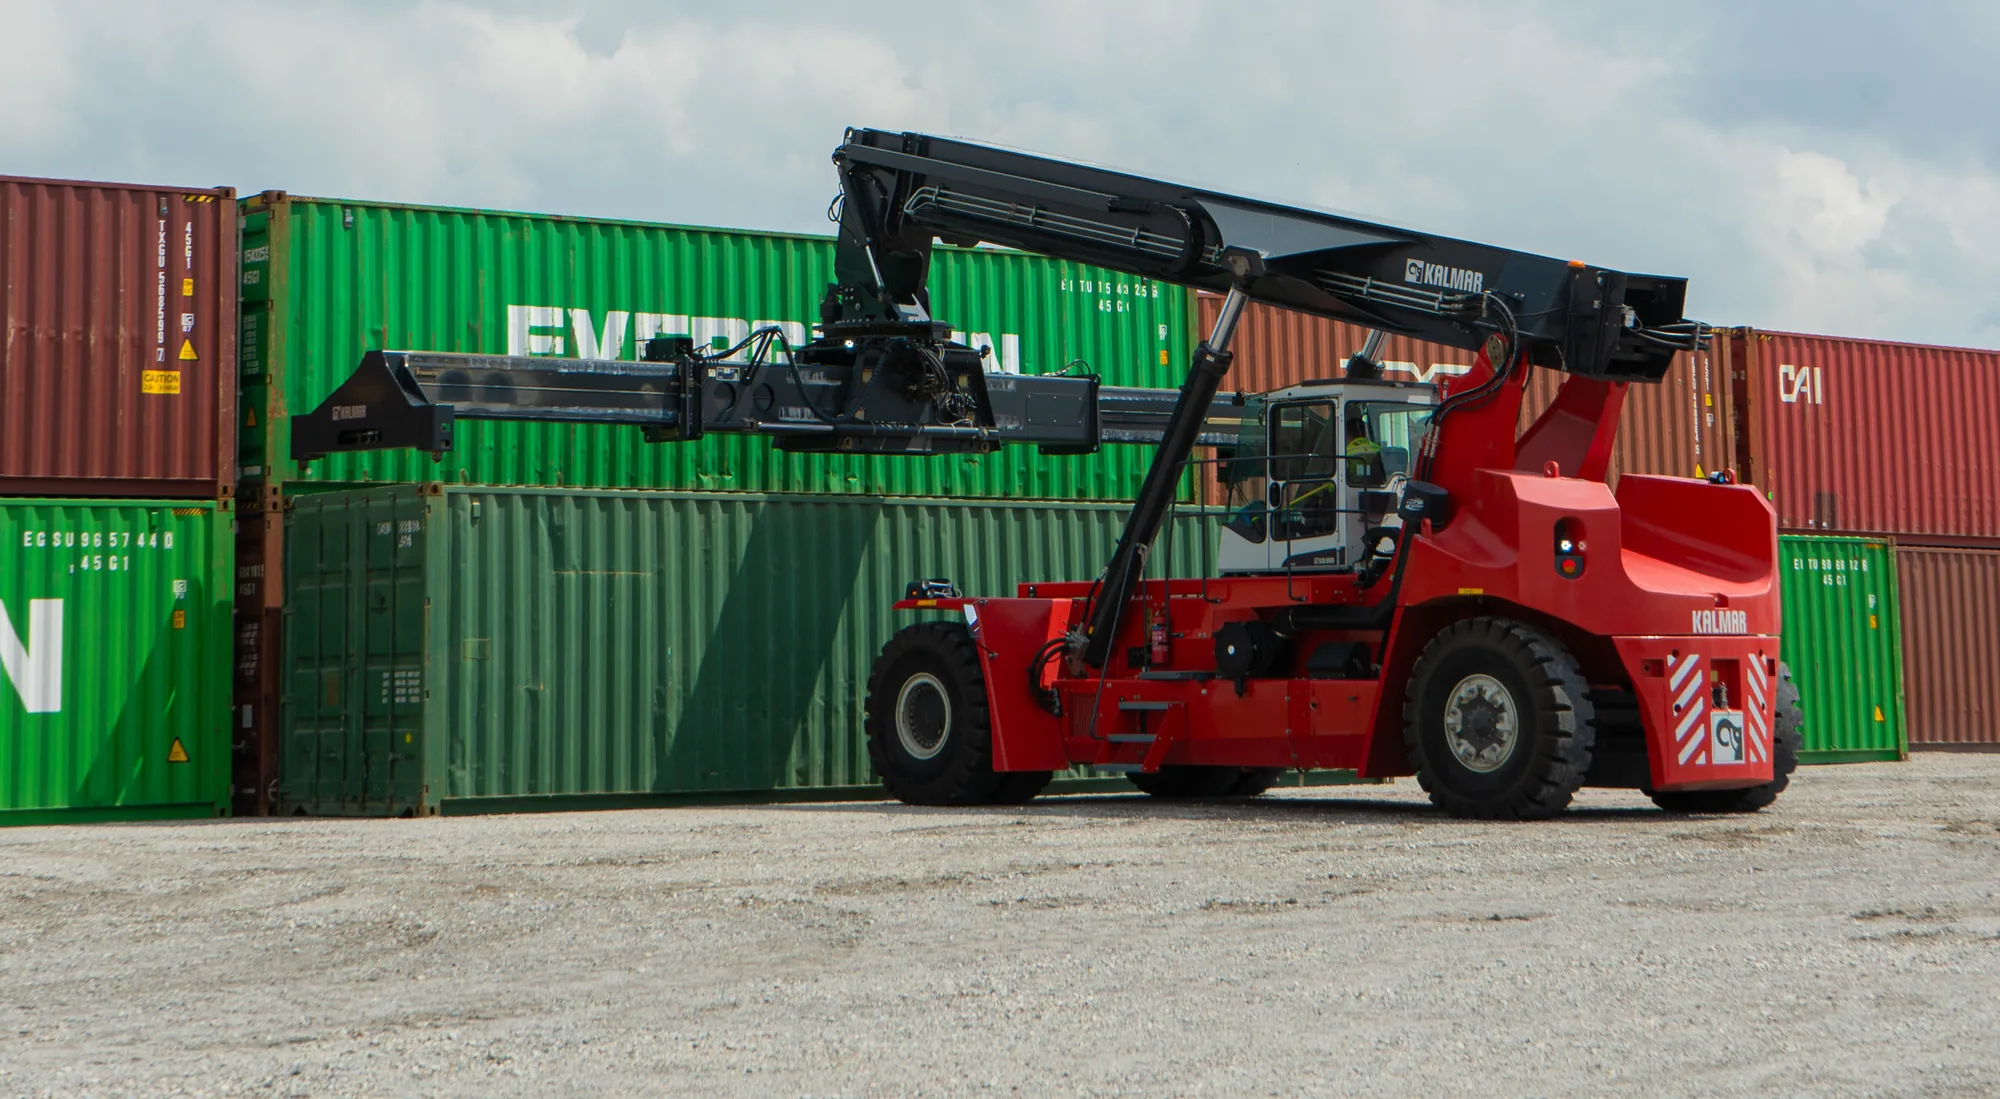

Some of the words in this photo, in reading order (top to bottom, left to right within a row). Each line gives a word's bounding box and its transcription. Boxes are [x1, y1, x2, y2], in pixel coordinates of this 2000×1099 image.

[184, 221, 192, 269] 45G1
[1424, 263, 1484, 294] KALMAR
[144, 373, 179, 383] CAUTION
[1779, 364, 1822, 405] CAI
[1692, 610, 1747, 634] KALMAR
